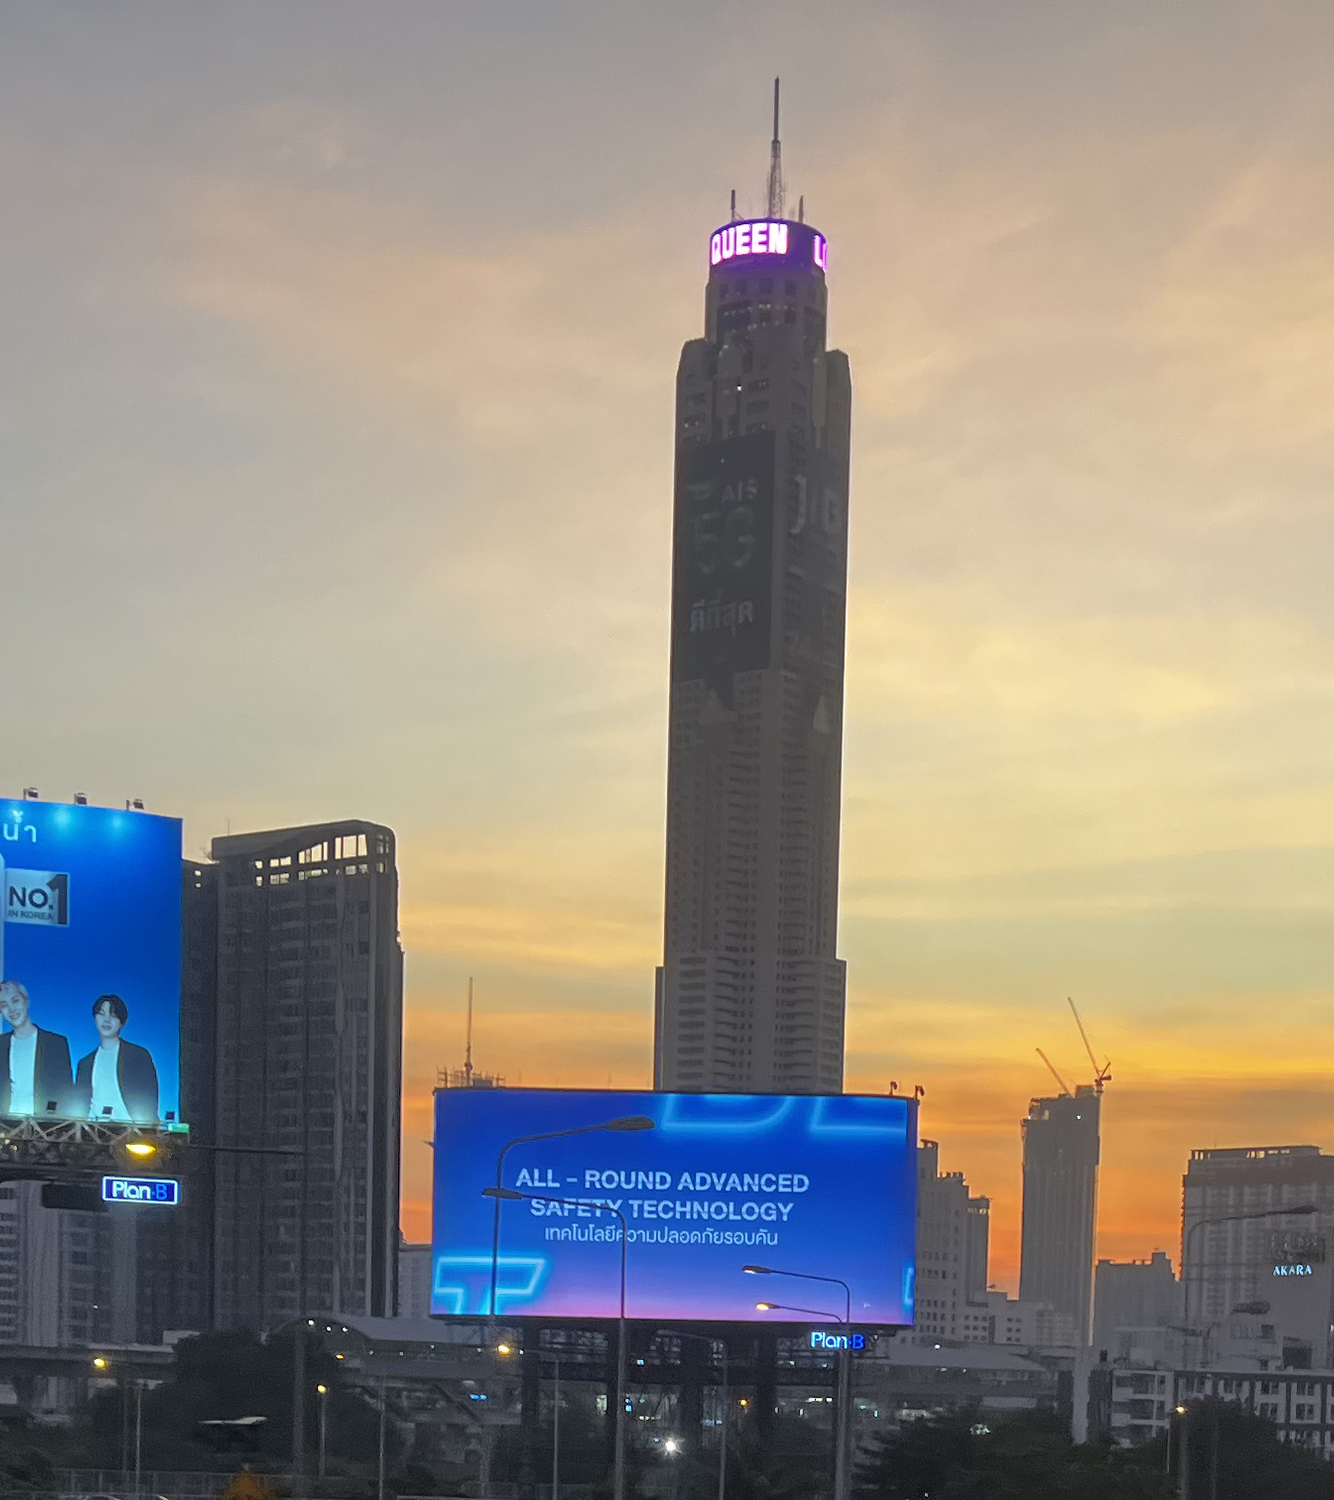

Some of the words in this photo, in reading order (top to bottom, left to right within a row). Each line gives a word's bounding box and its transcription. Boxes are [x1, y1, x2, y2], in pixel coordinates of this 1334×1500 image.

[711, 222, 788, 265] QUEEN
[21, 911, 53, 920] KOREA
[516, 1168, 560, 1188] ALL
[584, 1170, 671, 1191] ROUND
[677, 1172, 810, 1193] ADVANCED
[530, 1198, 622, 1218] SAFETY
[628, 1200, 794, 1222] TECHNOLOGY
[1273, 1264, 1313, 1276] AKARA
